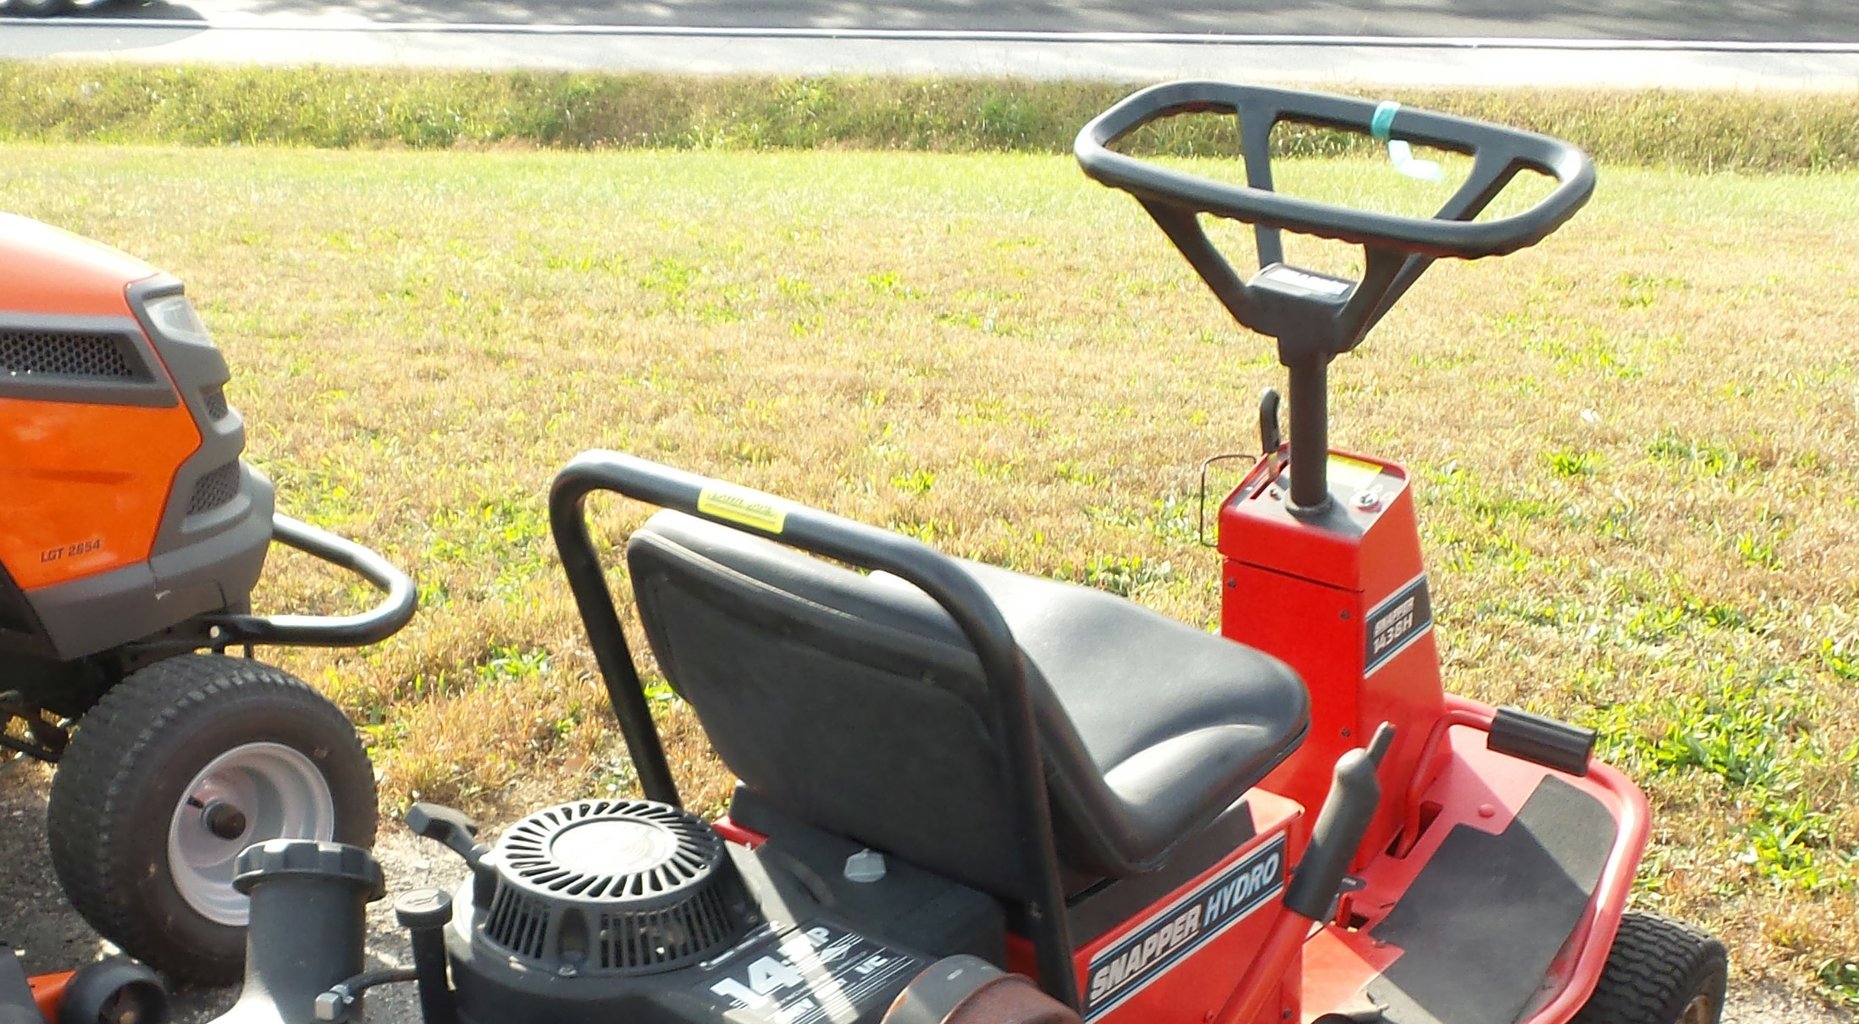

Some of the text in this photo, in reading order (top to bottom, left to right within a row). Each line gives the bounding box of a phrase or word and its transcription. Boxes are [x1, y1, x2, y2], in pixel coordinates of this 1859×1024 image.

[41, 547, 64, 563] LGT
[1090, 852, 1280, 1003] SNAPPER HYDRO
